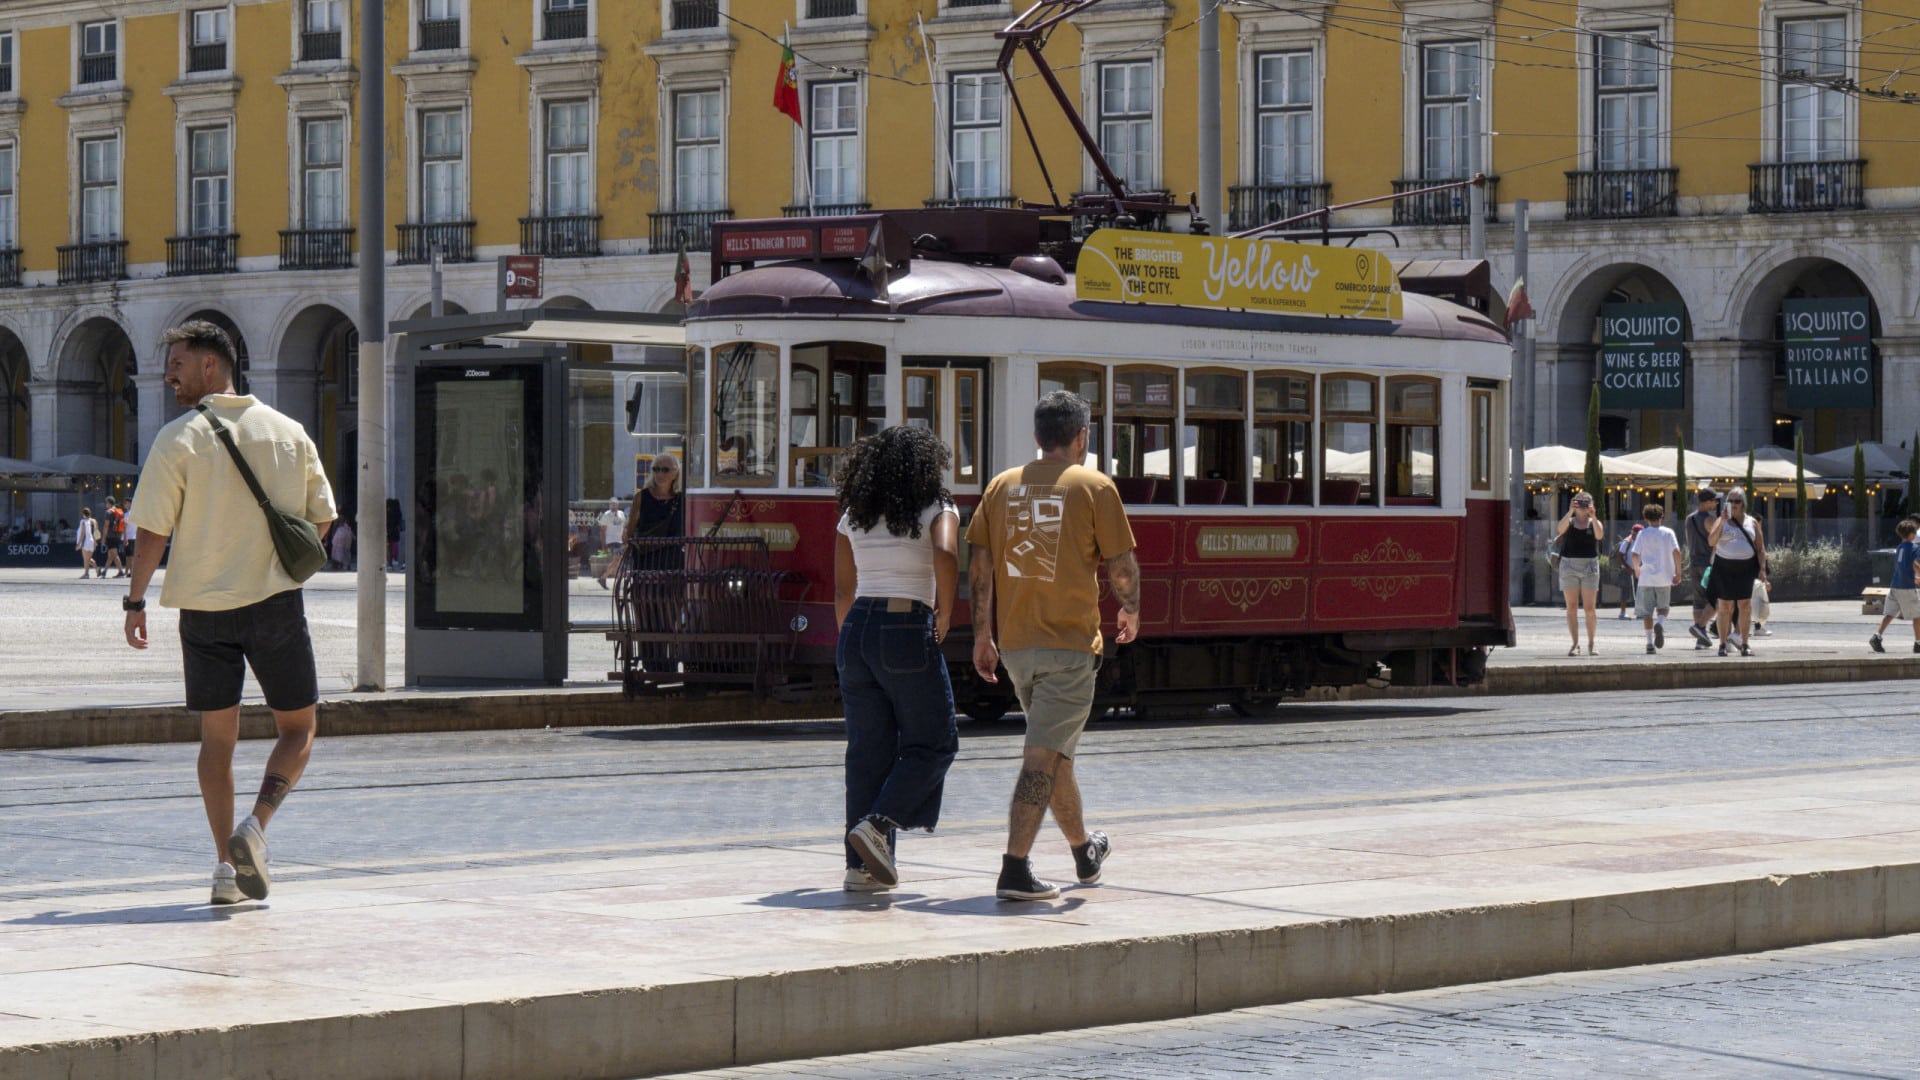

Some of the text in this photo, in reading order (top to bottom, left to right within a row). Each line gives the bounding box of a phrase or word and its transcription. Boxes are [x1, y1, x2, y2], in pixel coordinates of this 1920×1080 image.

[727, 236, 807, 251] HILLS TRAMCAR TOUR
[1114, 247, 1183, 264] THE BRIGHTER
[1119, 263, 1181, 280] WAY TO FEEL
[1201, 241, 1320, 301] Yellow
[1128, 280, 1146, 294] THE
[1147, 281, 1173, 296] CITY.
[735, 324, 743, 336] 12
[1610, 316, 1681, 338] SQUISITO
[1791, 311, 1866, 334] SQUISITO
[1181, 339, 1206, 349] LISBON
[1210, 339, 1247, 350] HISTORICAL
[1253, 341, 1285, 352] PREMIUM
[1604, 352, 1681, 368] WINE & BEER
[1787, 347, 1868, 362] RISTORANTE
[1604, 372, 1681, 389] COCKTAILS
[1788, 367, 1869, 385] ITALIANO
[764, 528, 792, 544] TOUR
[1202, 533, 1292, 551] HILLS TRAMCAR TOUR
[7, 544, 50, 555] SEAFOOD
